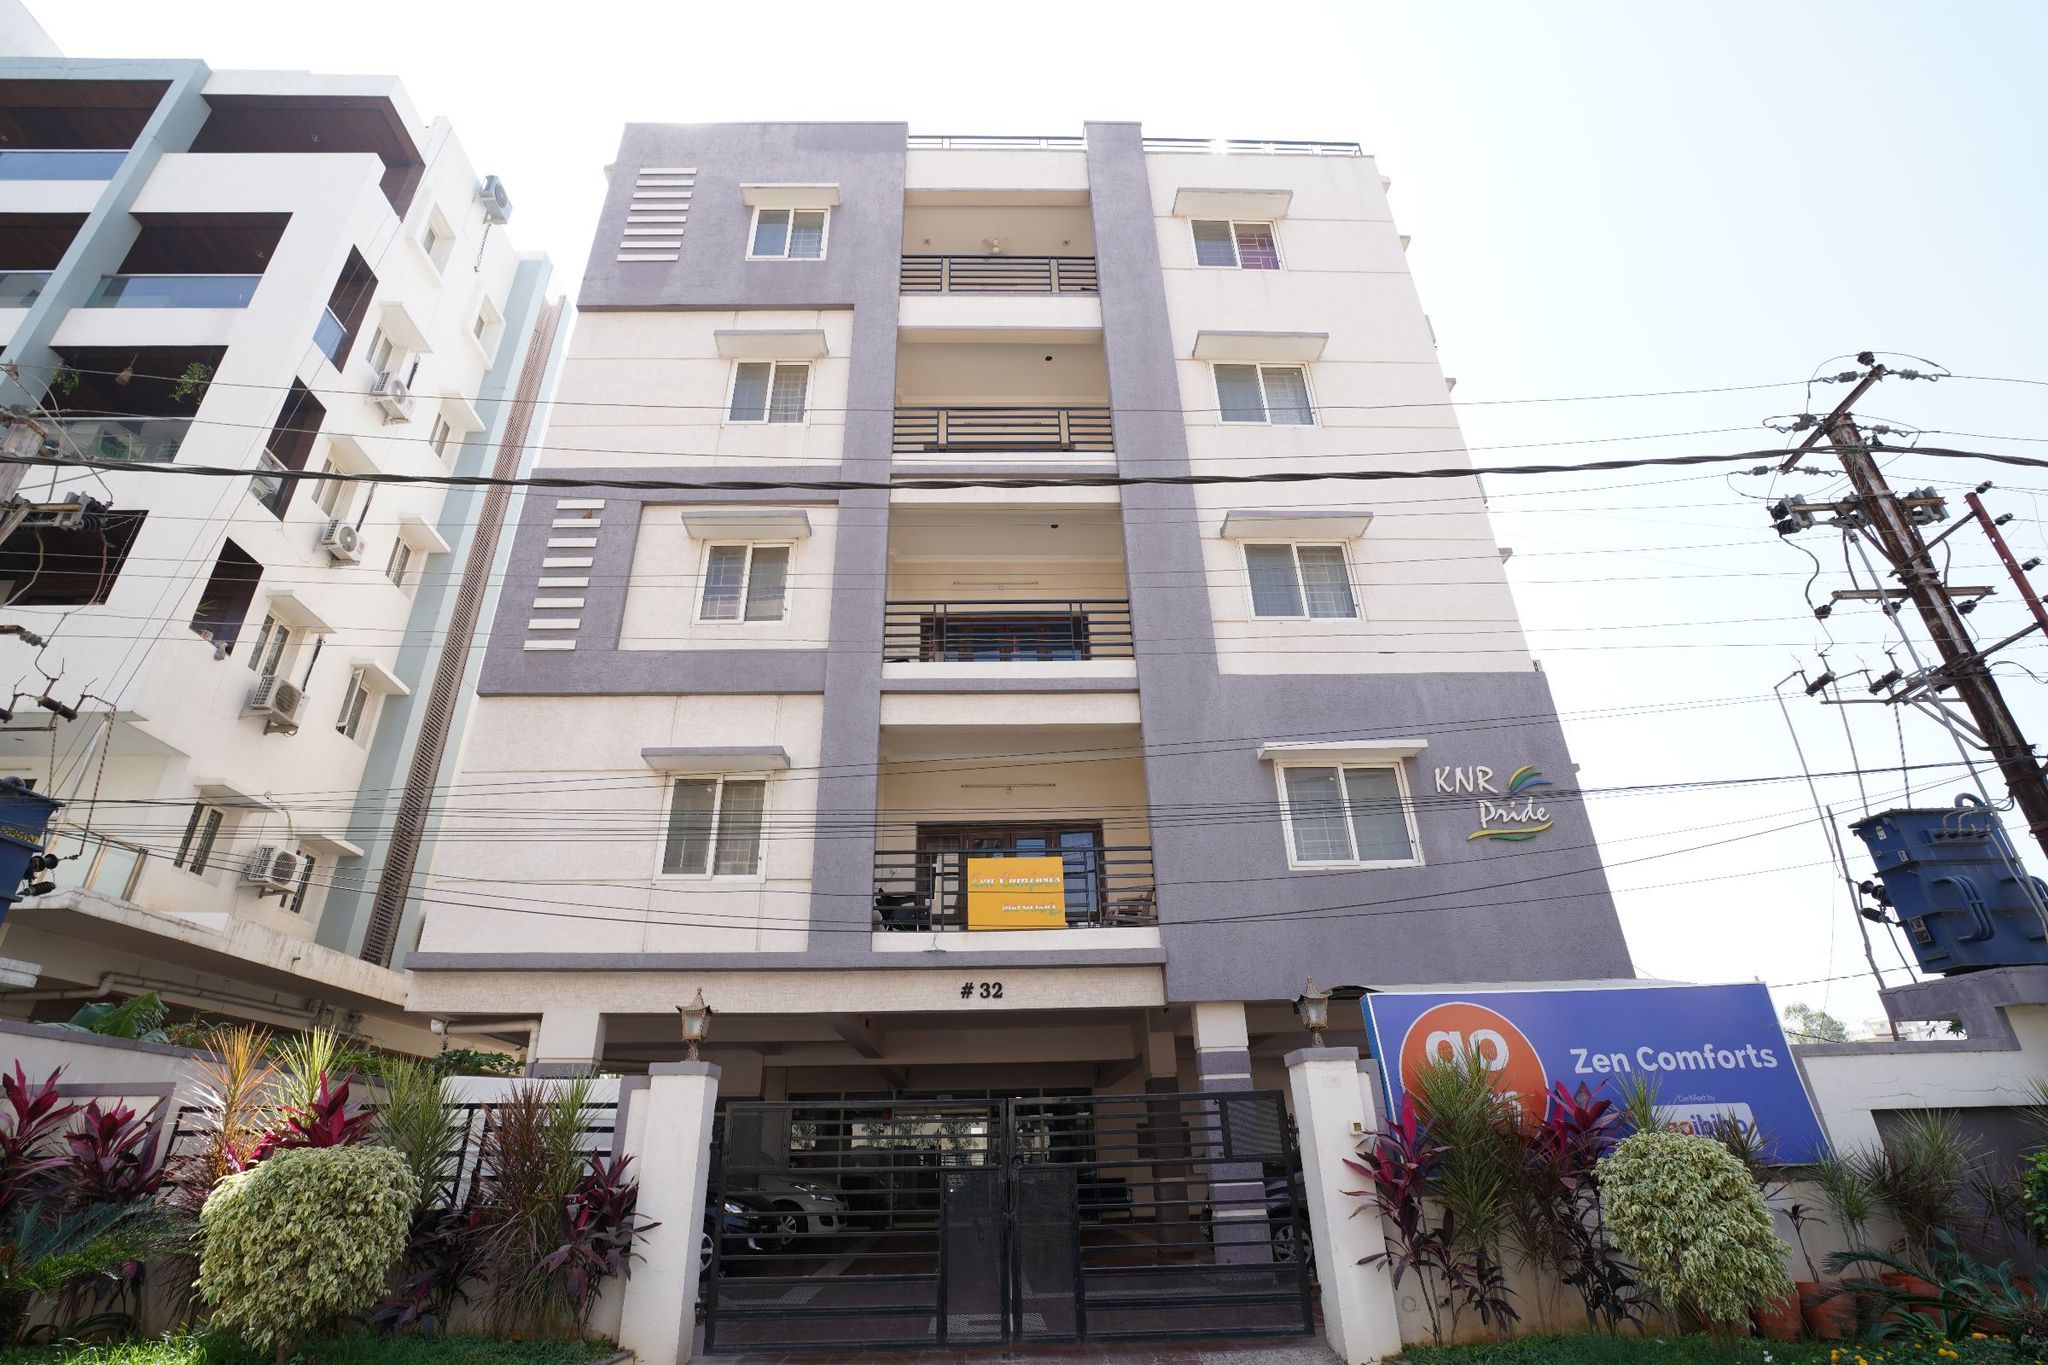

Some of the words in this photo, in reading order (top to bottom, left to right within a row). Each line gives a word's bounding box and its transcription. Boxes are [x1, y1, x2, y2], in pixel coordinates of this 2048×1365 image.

[1435, 765, 1498, 793] KNR
[1477, 797, 1550, 829] Pride
[1570, 1047, 1631, 1074] Zen
[1636, 1043, 1778, 1072] Comforts
